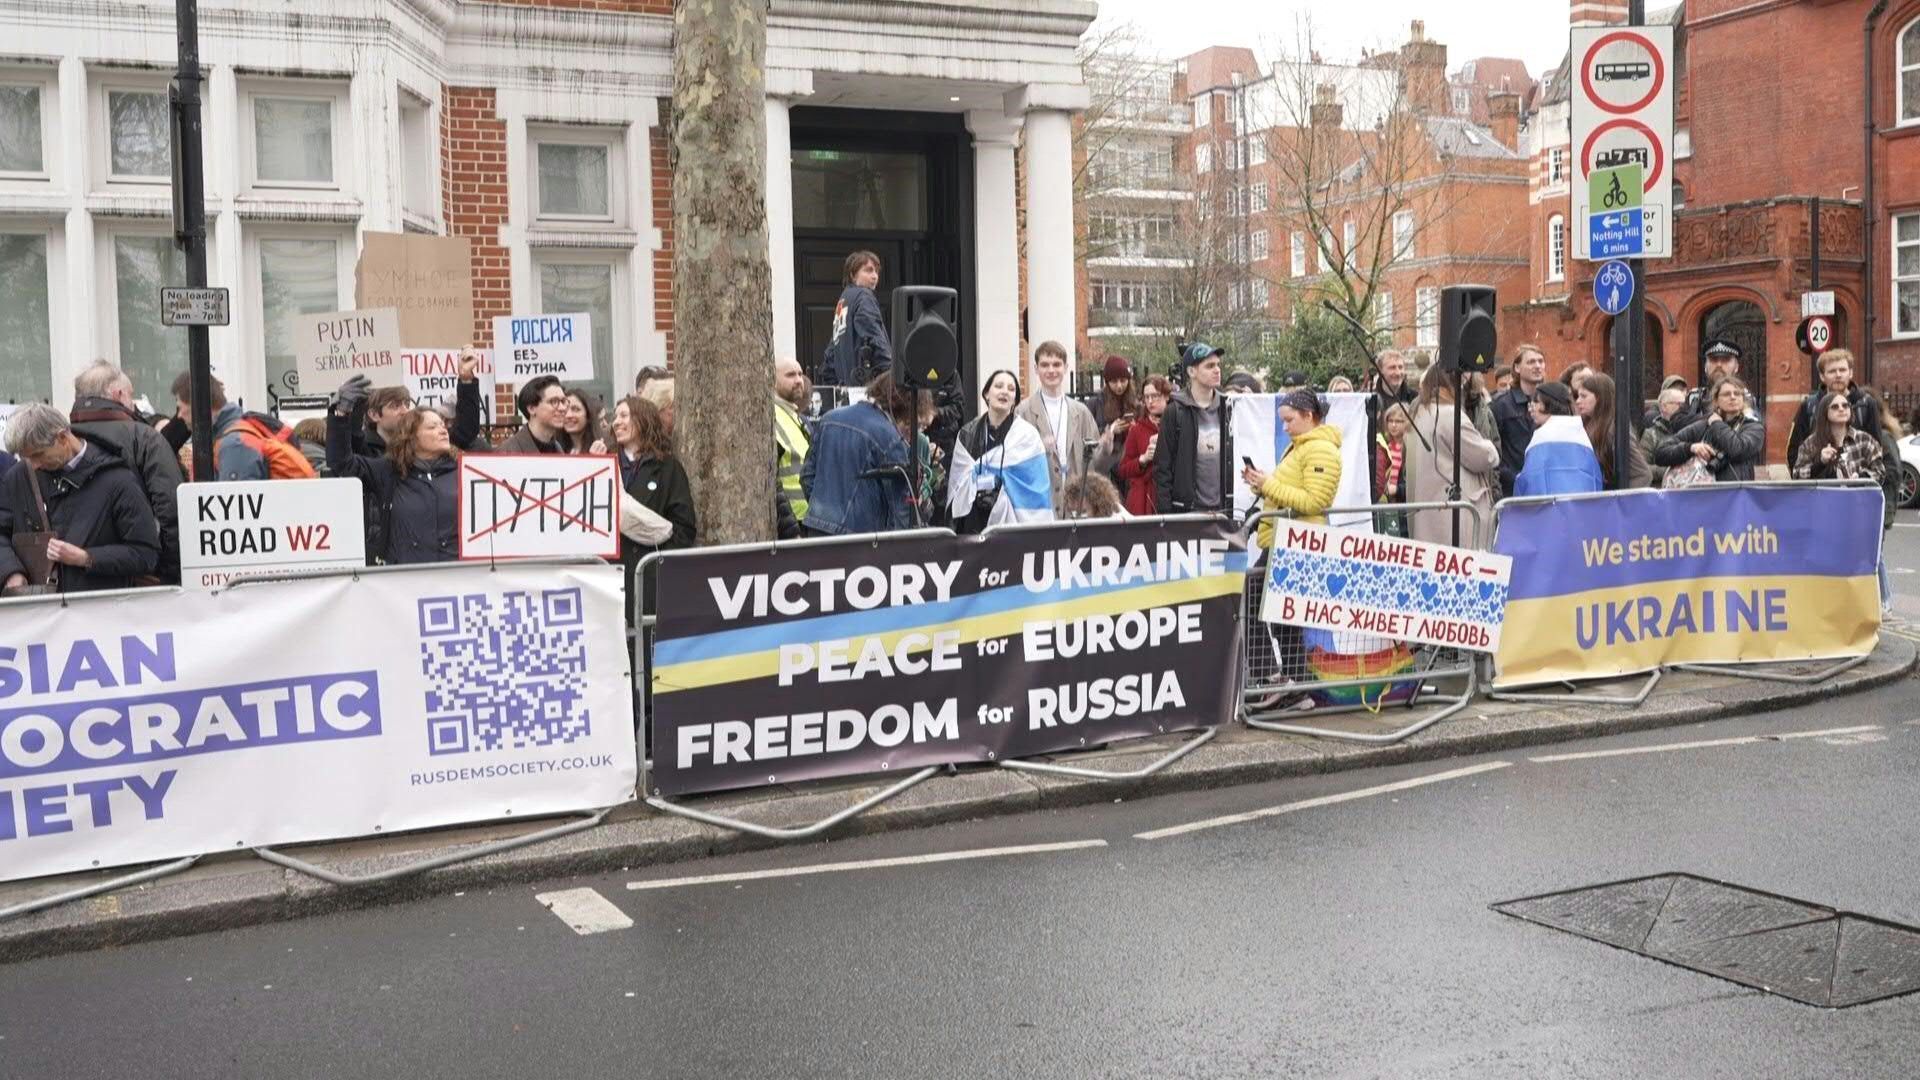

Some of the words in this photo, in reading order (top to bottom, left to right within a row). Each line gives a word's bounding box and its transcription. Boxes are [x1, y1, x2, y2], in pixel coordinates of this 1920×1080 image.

[1592, 229, 1623, 242] Notting
[1624, 227, 1639, 238] Hill
[1603, 245, 1609, 253] 6
[1610, 243, 1629, 253] mins
[167, 291, 182, 300] No
[186, 291, 223, 302] loading
[170, 301, 192, 310] Mon
[203, 301, 221, 310] Sat
[170, 311, 191, 320] 7am
[202, 311, 223, 322] 7pm
[317, 316, 375, 342] PUTIN
[511, 317, 572, 344] РОССИЯ
[1811, 326, 1828, 341] 20
[329, 343, 340, 354] IS
[347, 341, 357, 353] A
[513, 348, 539, 361] БЕЗ
[314, 354, 350, 372] SERIAL
[352, 350, 392, 368] KILLER
[401, 353, 492, 376] ПОЛДЬ
[514, 361, 567, 375] ПУТИНА
[1780, 361, 1791, 380] 2
[420, 376, 457, 390] ПРОТ
[198, 493, 264, 522] KYIV
[470, 477, 613, 534] ПУТИН
[200, 527, 277, 556] ROAD
[286, 524, 331, 552] W2
[1287, 528, 1327, 552] МЫ
[1340, 535, 1426, 568] СИЛЬНЕЕ
[1582, 537, 1623, 567] We
[1628, 527, 1705, 562] stand
[1713, 524, 1778, 555] with
[201, 572, 231, 587] CITY
[708, 560, 963, 620] VICTORY
[978, 568, 1009, 587] for
[1022, 540, 1230, 593] UKRAINE
[1282, 597, 1295, 620] В
[1304, 600, 1342, 625] НАС
[1347, 608, 1414, 636] ЖИВЕТ
[1417, 617, 1490, 647] ЛЮБОВЬ
[1575, 589, 1788, 651] UKRAINE
[778, 630, 962, 687] PEACE
[977, 637, 1008, 656] for
[1023, 603, 1203, 662] EUROPE
[0, 680, 373, 768] OCRATIC
[677, 698, 959, 769] FREEDOM
[977, 704, 1014, 725] for
[1028, 670, 1186, 731] RUSSIA
[410, 754, 614, 786] RUSDEMSOCIETY.CO.UK
